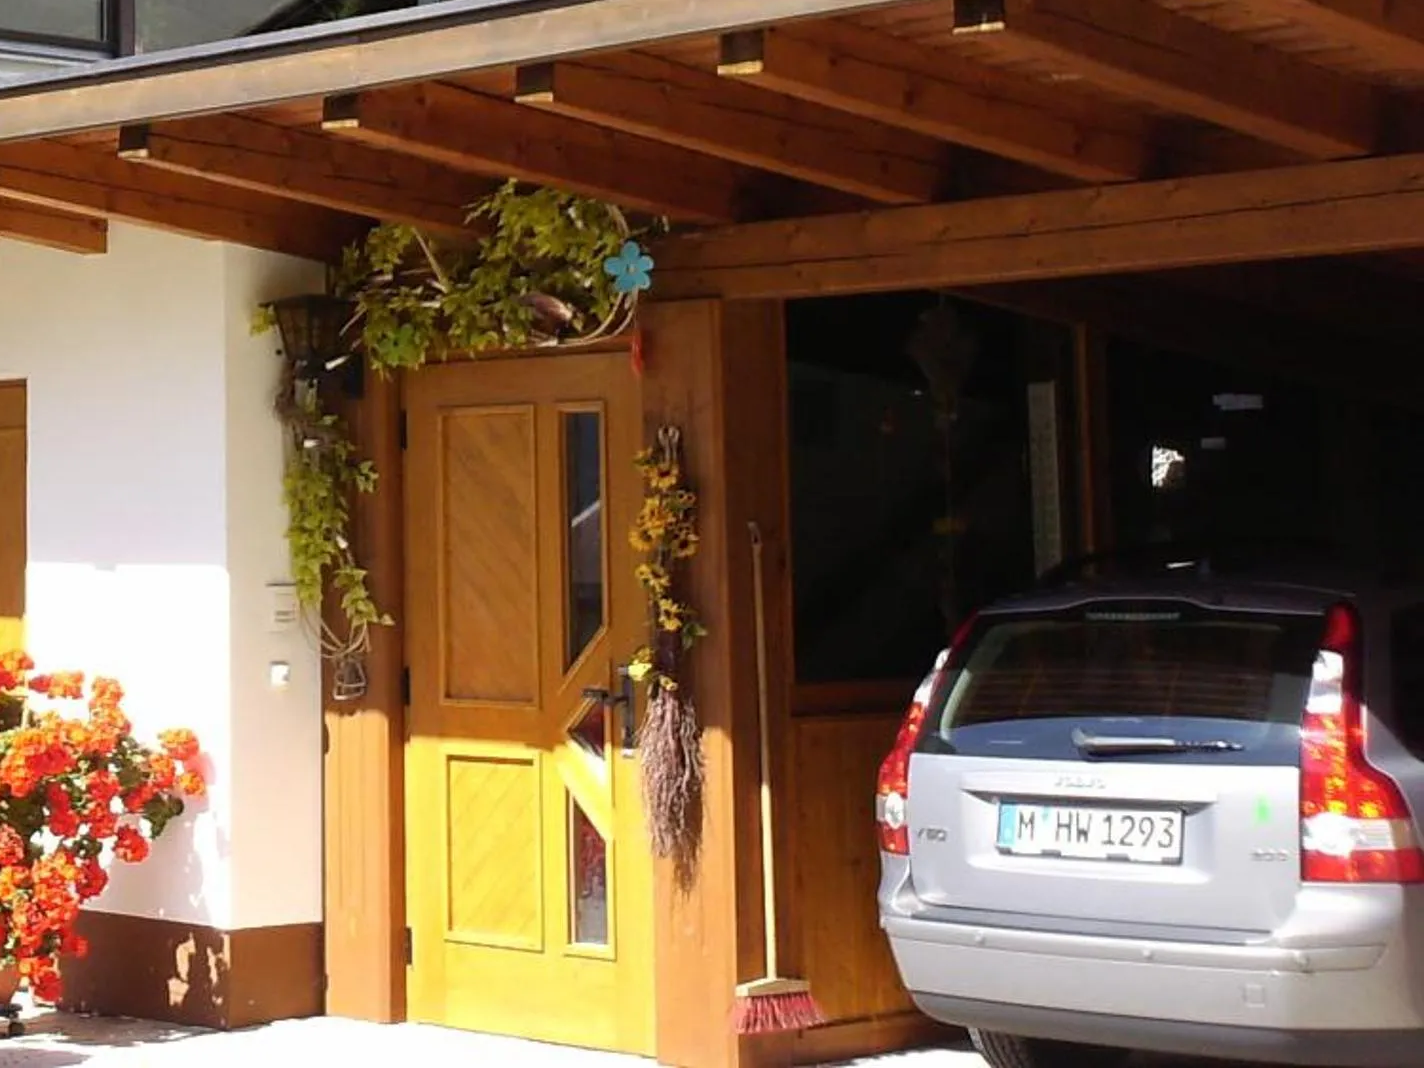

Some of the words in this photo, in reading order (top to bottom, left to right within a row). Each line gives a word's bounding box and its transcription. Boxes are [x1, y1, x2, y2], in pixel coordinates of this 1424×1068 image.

[1017, 811, 1036, 841] M
[1055, 811, 1093, 844] HW
[1101, 814, 1175, 849] 1293
